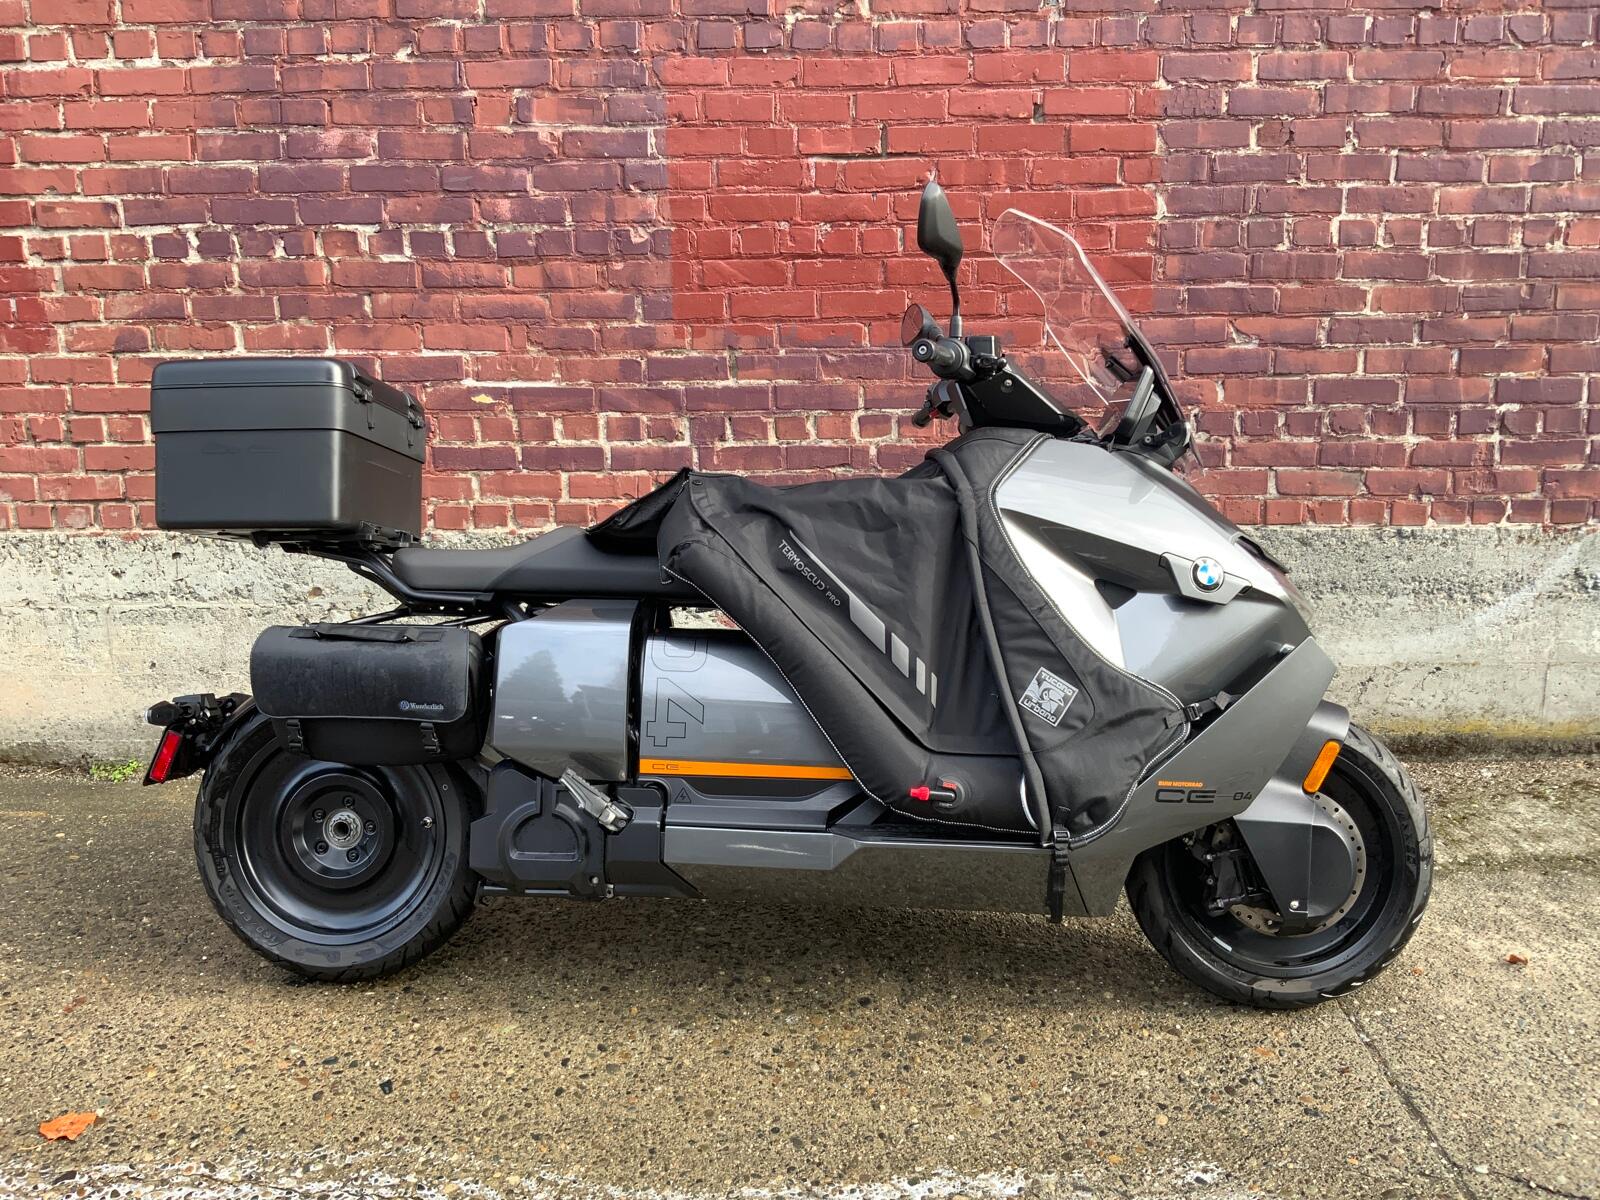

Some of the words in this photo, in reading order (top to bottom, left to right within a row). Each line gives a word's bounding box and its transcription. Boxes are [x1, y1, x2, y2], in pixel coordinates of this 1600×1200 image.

[825, 590, 841, 606] PRO
[409, 702, 445, 711] Wunderlich
[1155, 788, 1217, 804] CE
[1232, 791, 1253, 801] 04
